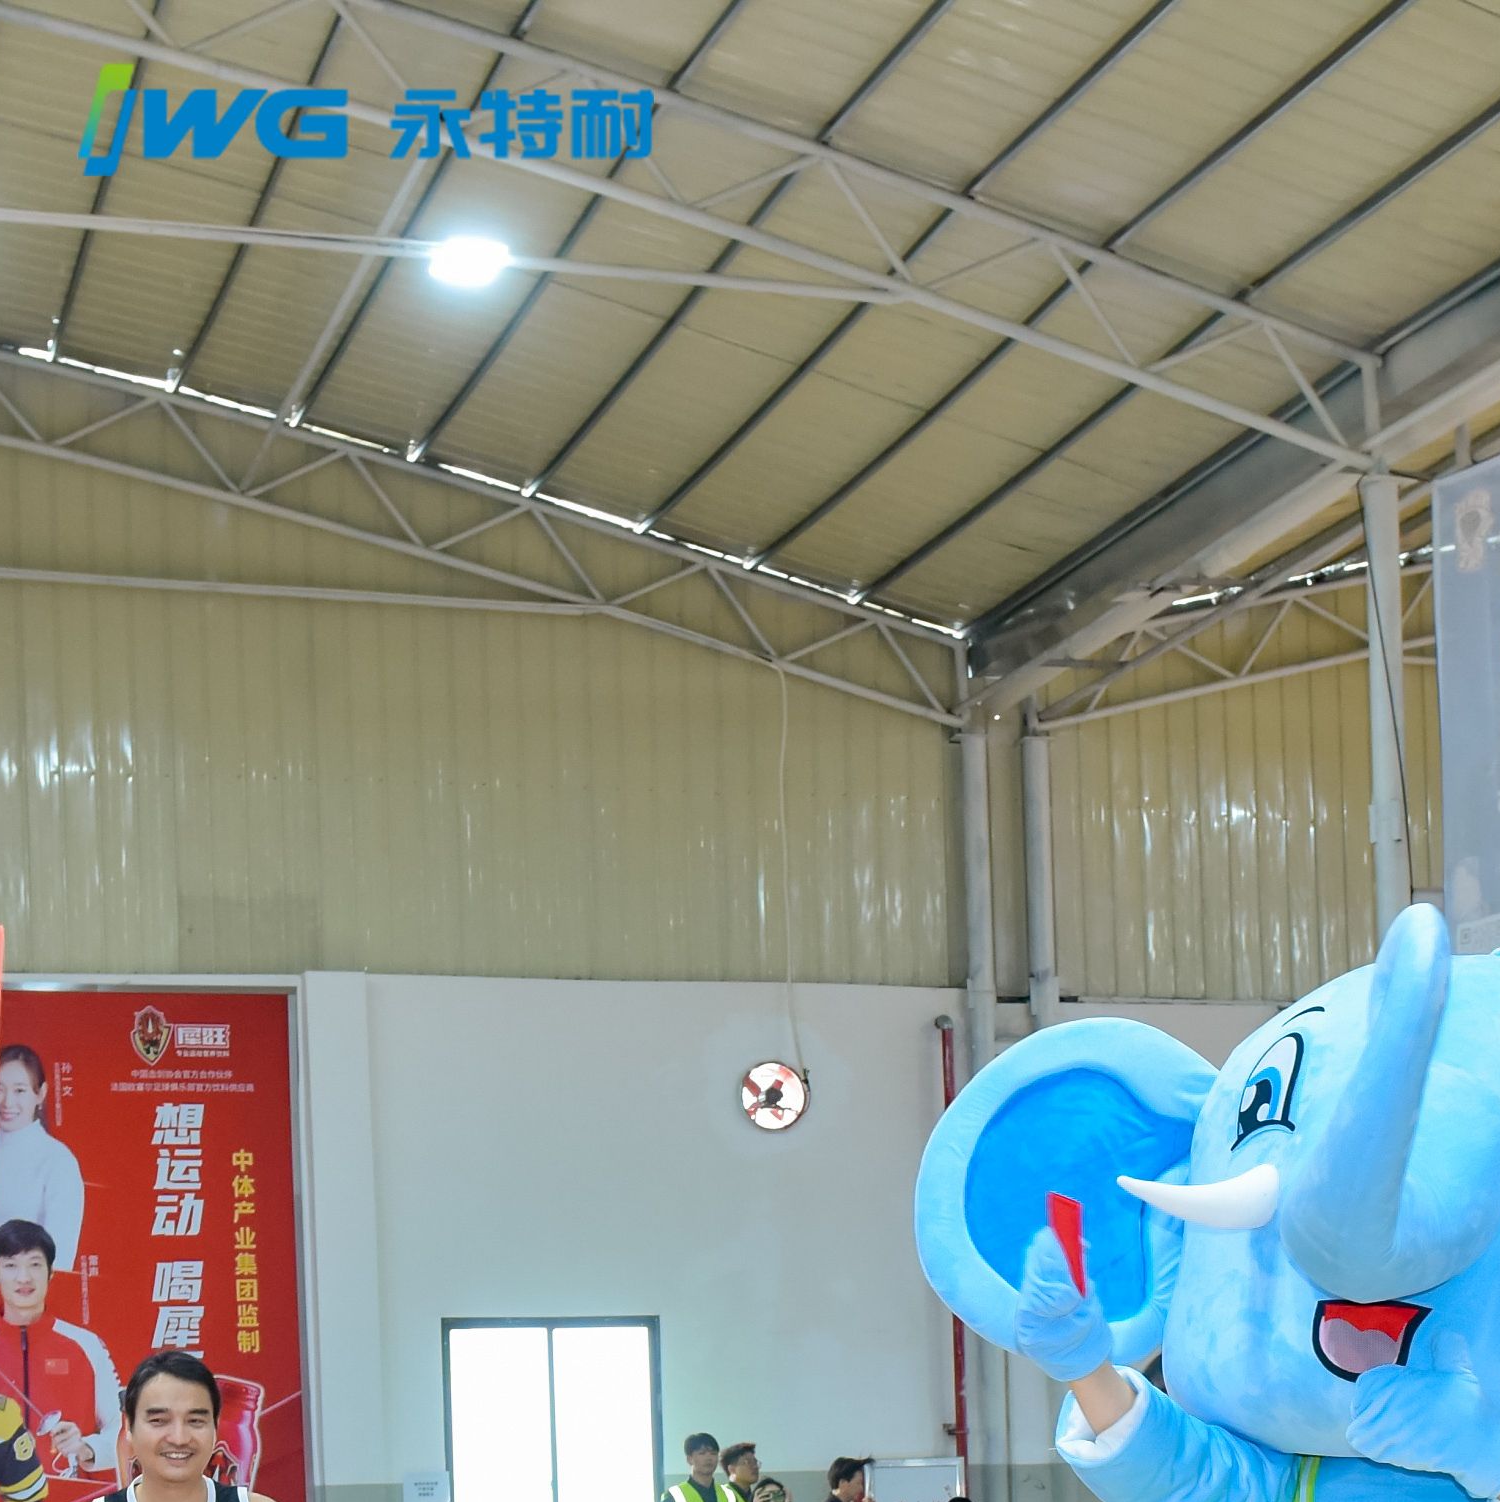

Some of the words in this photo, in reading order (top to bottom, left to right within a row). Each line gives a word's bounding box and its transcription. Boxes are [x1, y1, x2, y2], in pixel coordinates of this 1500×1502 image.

[151, 1103, 205, 1237] 想运动
[231, 1148, 260, 1355] 中体产业集团监制
